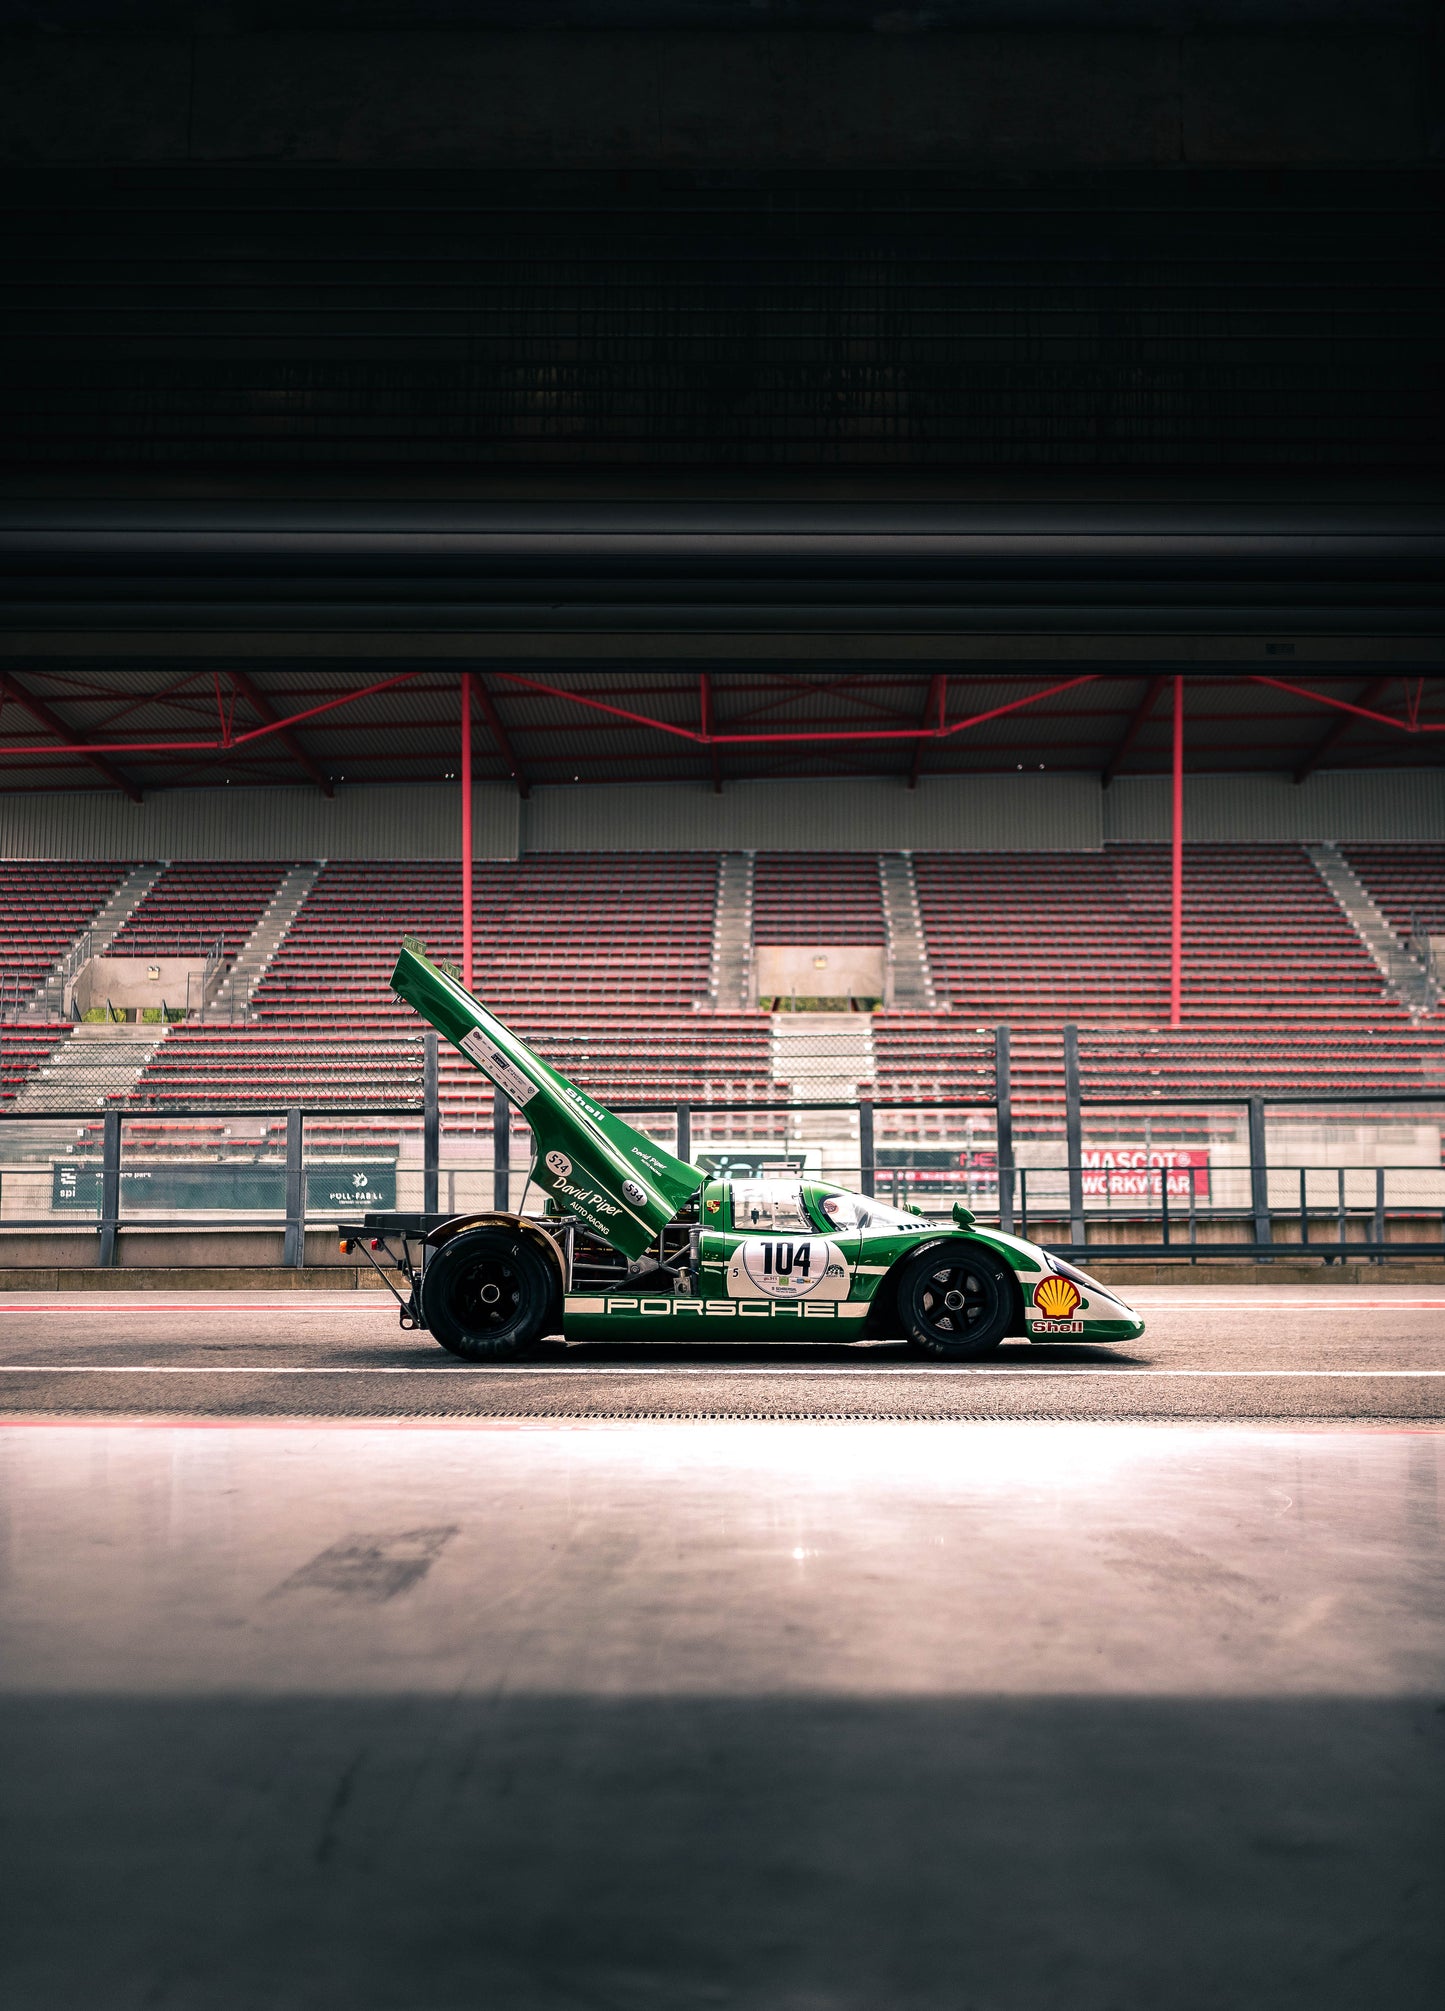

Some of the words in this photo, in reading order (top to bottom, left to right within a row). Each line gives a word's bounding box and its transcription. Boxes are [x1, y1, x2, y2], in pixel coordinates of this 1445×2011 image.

[565, 1087, 606, 1121] Shell
[548, 1154, 569, 1174] 524
[631, 1146, 653, 1161] David
[649, 1157, 668, 1170] Piper
[59, 1187, 76, 1199] spi
[552, 1176, 593, 1201] David
[588, 1194, 623, 1217] Piper
[625, 1183, 644, 1202] 534
[570, 1201, 588, 1217] AUTO
[586, 1214, 610, 1235] RACING
[760, 1242, 811, 1277] 104
[732, 1267, 739, 1278] 5
[607, 1298, 835, 1318] PORSCHE
[1032, 1321, 1083, 1333] Shell
